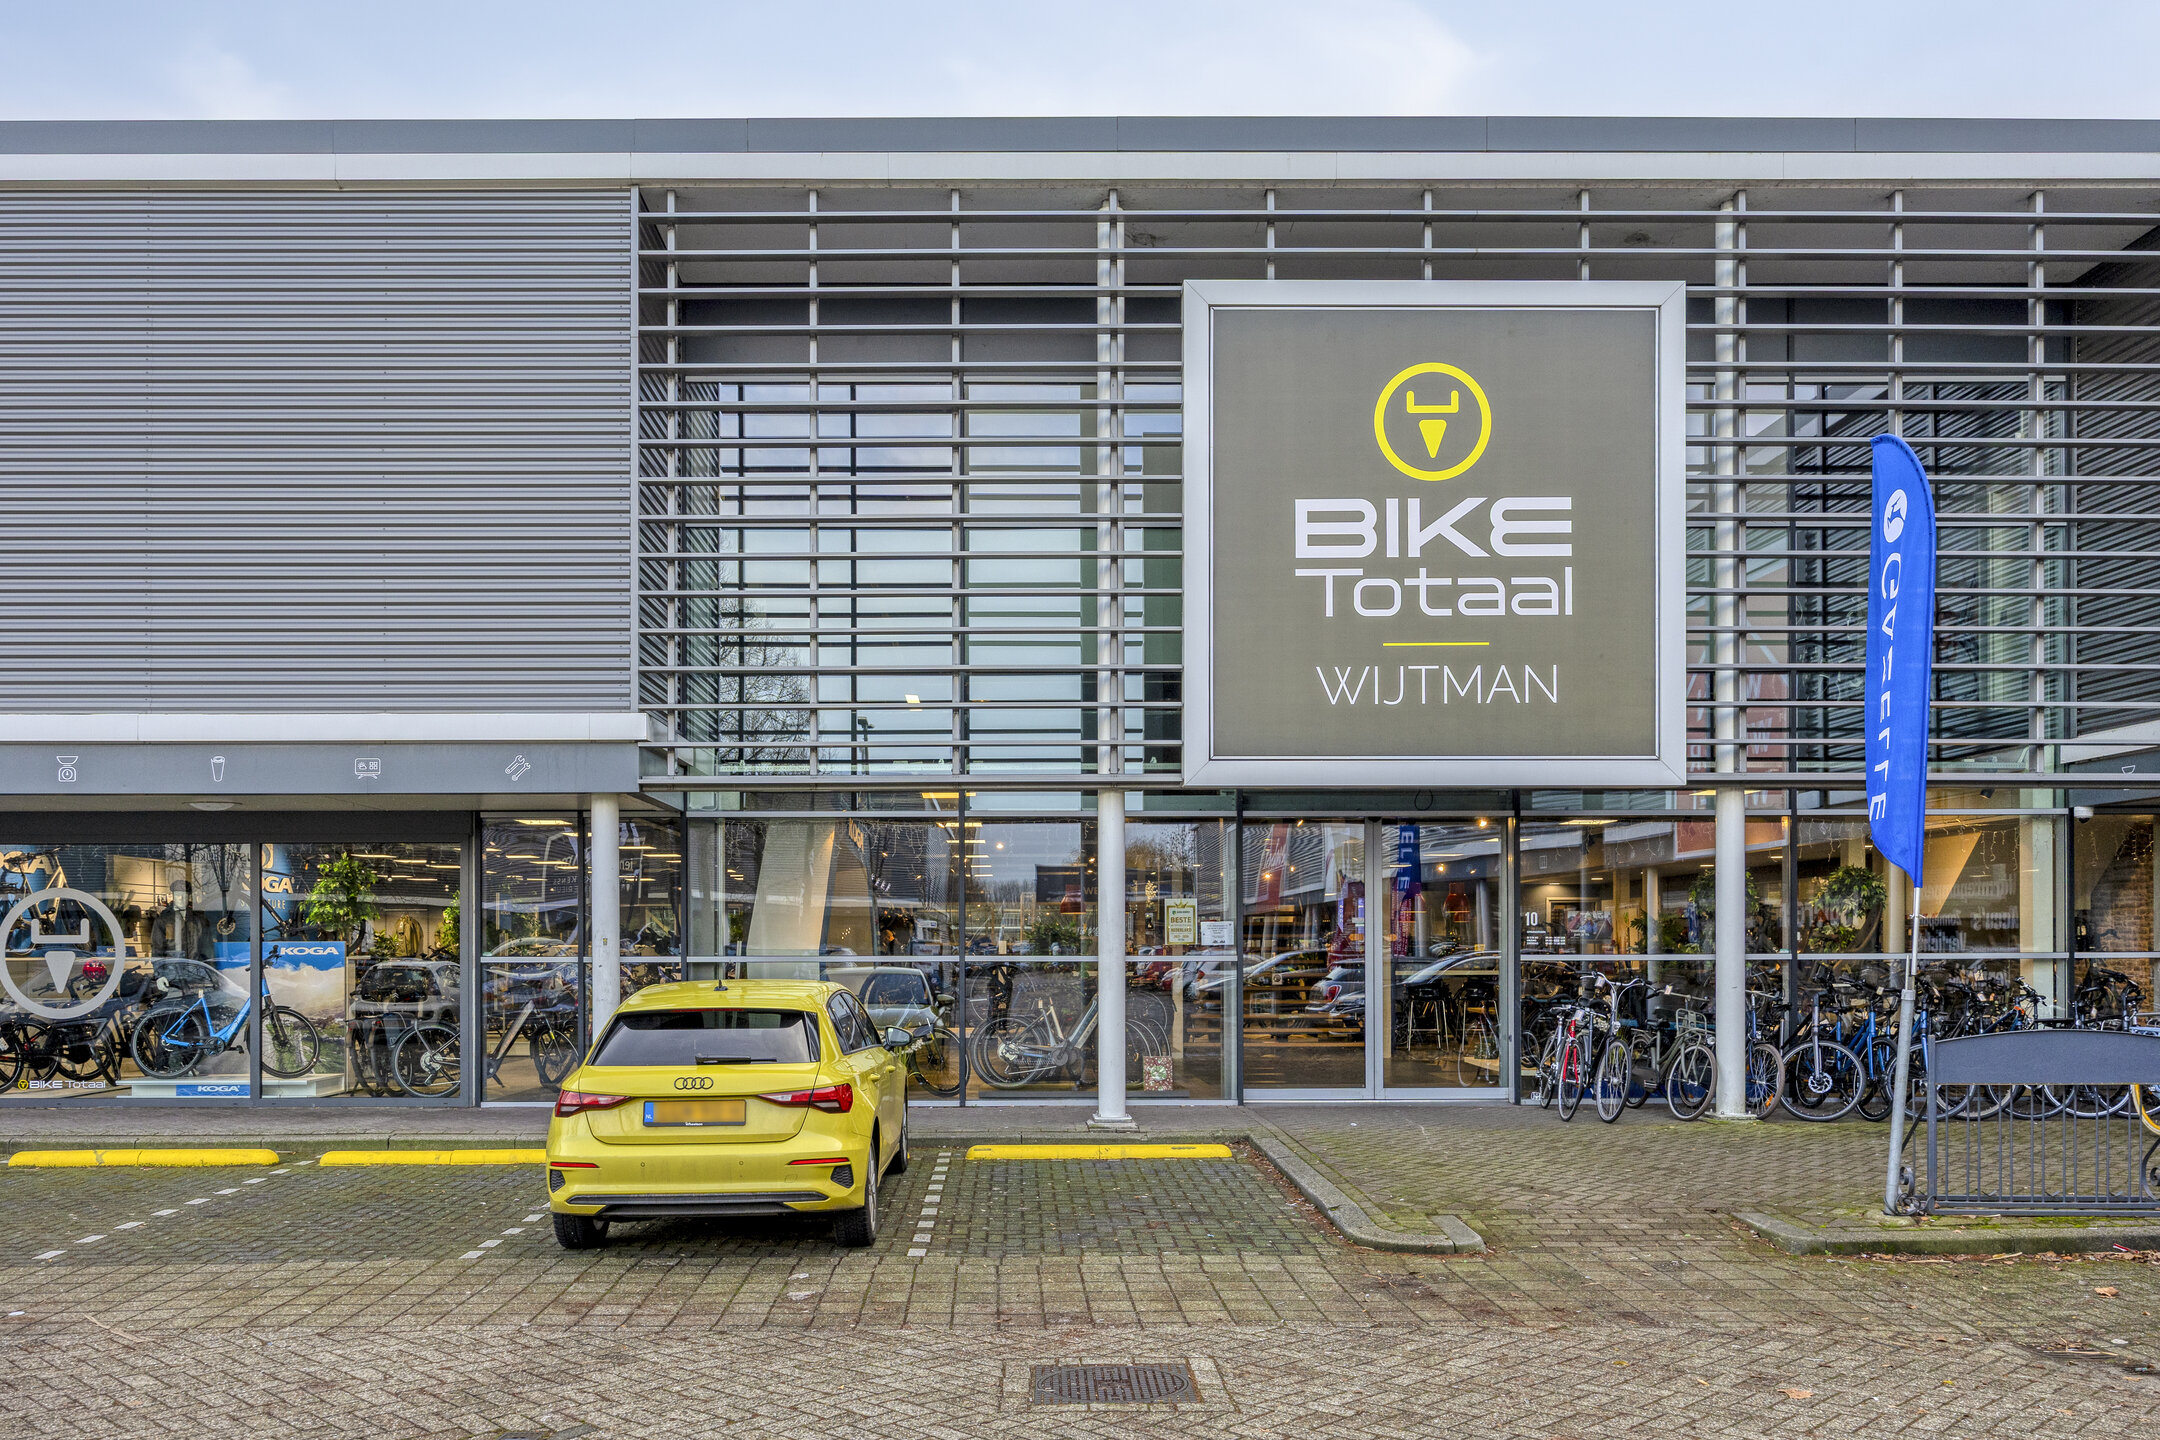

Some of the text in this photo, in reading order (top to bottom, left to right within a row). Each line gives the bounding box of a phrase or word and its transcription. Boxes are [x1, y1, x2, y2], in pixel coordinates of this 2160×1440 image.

[1294, 496, 1573, 558] BIKE
[1294, 566, 1573, 618] Totaal
[1315, 664, 1557, 705] WIJTMAN
[1524, 911, 1538, 926] 10
[279, 946, 339, 956] KOGA
[28, 1079, 106, 1089] BIKE Totaal
